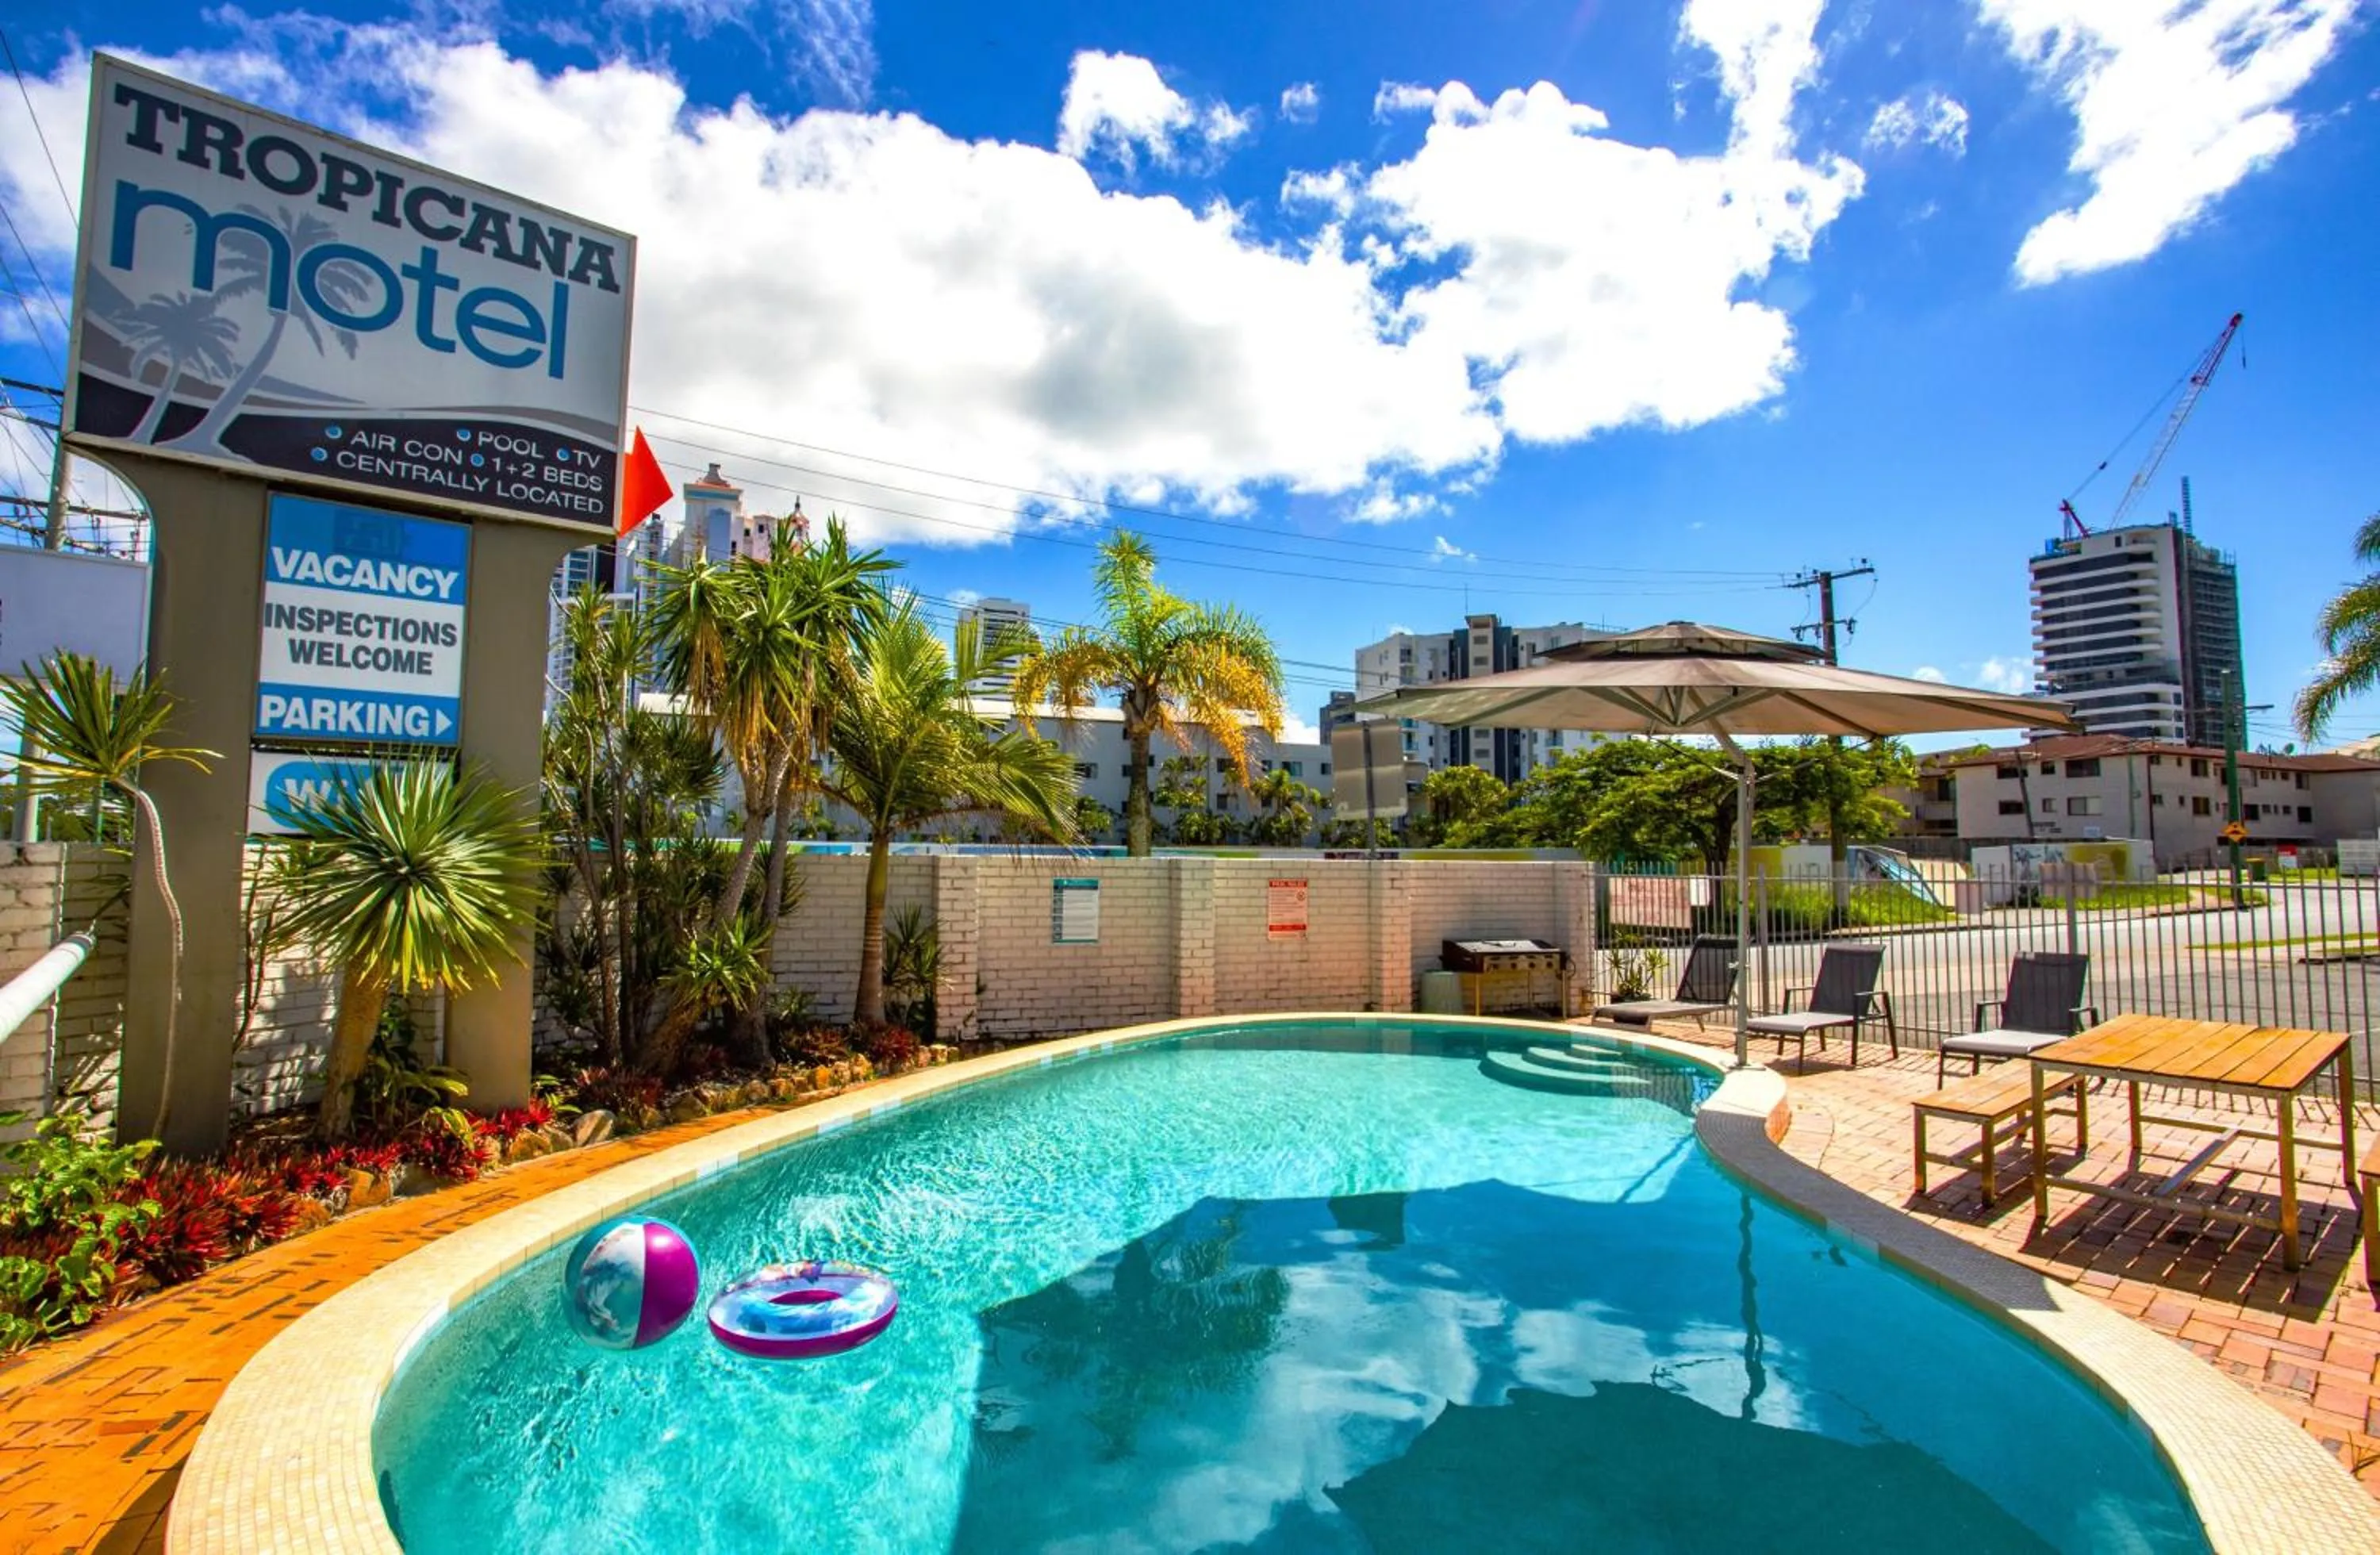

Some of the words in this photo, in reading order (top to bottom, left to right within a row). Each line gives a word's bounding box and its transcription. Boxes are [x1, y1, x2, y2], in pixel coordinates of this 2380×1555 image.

[113, 83, 620, 294] TROPICANA
[110, 179, 569, 379] motel
[351, 431, 396, 452] AIR
[404, 440, 463, 465] CON
[492, 458, 536, 478] 1+2
[543, 466, 603, 492] BEDS
[478, 432, 544, 459] POOL
[571, 449, 601, 468] TV
[336, 451, 489, 493] CENTRALLY
[497, 481, 604, 514] LOCATED
[271, 546, 459, 599] VACANCY
[264, 602, 458, 647] INSPECTIONS
[288, 638, 432, 674] WELCOME
[259, 694, 430, 737] PARKING
